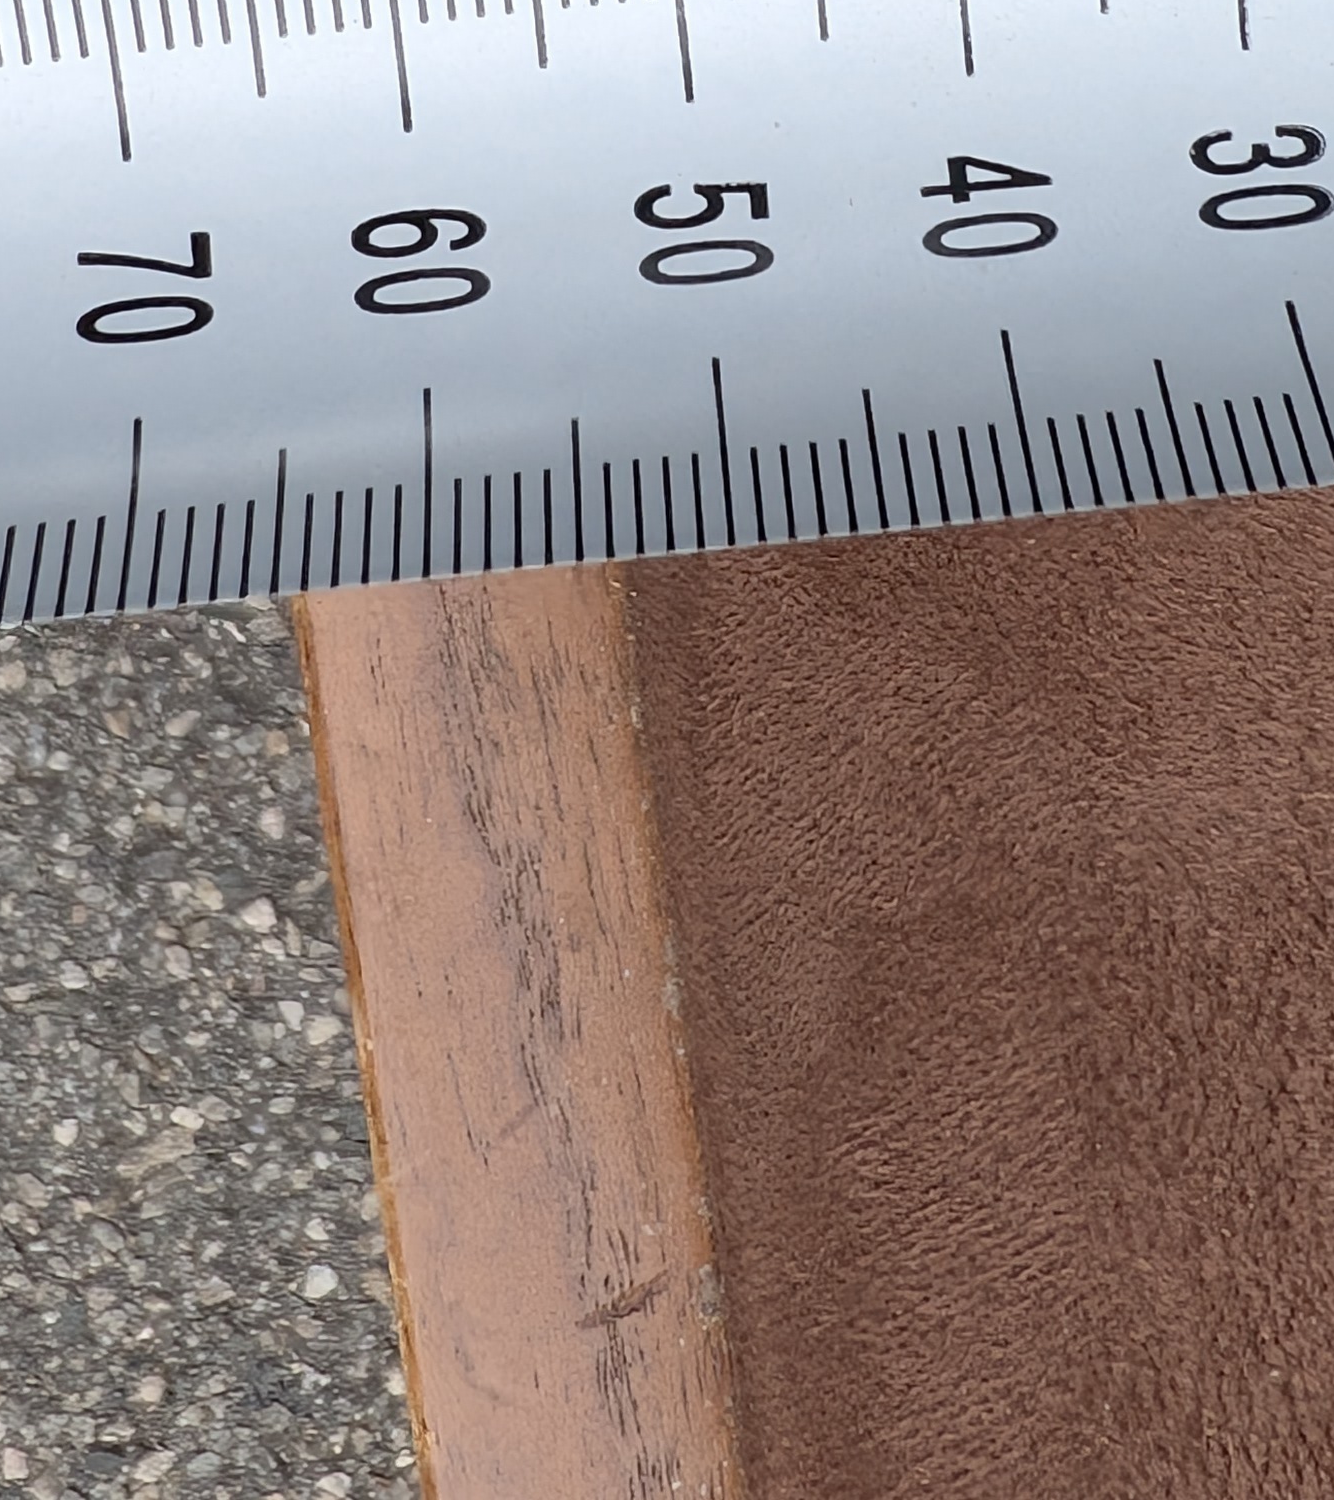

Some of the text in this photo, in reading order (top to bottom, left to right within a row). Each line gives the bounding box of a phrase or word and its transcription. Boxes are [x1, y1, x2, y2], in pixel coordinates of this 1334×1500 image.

[633, 181, 776, 287] 50
[920, 154, 1060, 259] 40
[75, 230, 215, 345] 70
[350, 207, 492, 316] 60
